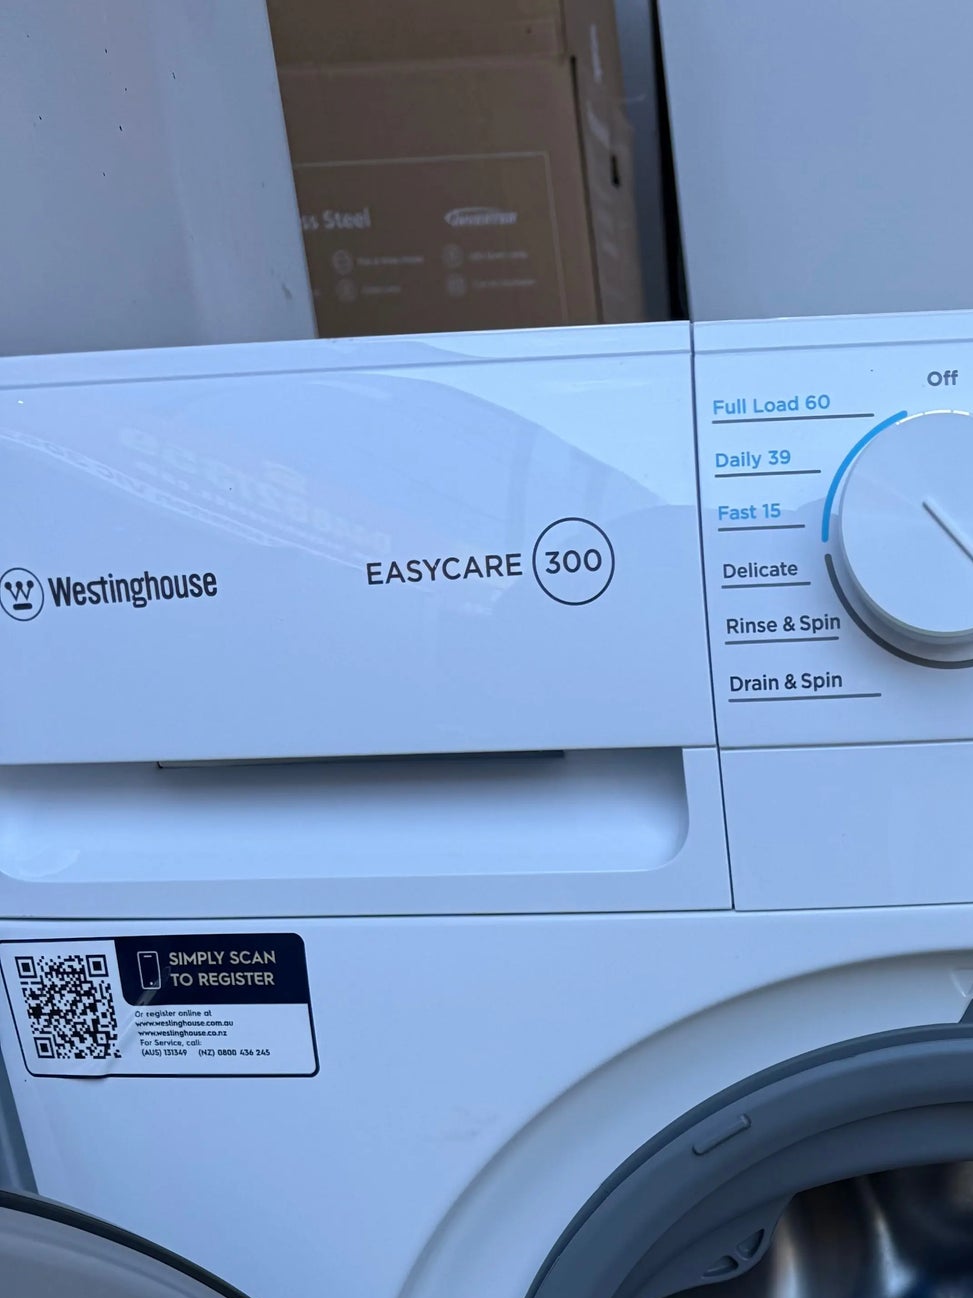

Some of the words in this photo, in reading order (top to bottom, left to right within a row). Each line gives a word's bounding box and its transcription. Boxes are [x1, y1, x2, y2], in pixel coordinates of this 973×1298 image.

[323, 207, 371, 230] Steel
[926, 370, 958, 387] Off
[713, 398, 747, 415] Full
[753, 396, 799, 413] Load
[805, 394, 831, 411] 60
[715, 450, 762, 469] Daily
[768, 450, 791, 465] 39
[718, 505, 757, 521] Fast
[762, 503, 782, 519] 15
[366, 553, 523, 586] EASYCARE
[545, 548, 603, 575] 300
[723, 562, 798, 579] Delicate
[48, 571, 218, 608] Westinghouse
[726, 617, 777, 634] Rinse
[783, 616, 796, 631] &
[799, 614, 841, 634] Spin
[729, 675, 779, 692] Drain
[784, 674, 797, 689] &
[801, 672, 843, 692] Spin
[169, 951, 225, 966] SIMPLY
[229, 950, 276, 965] SCAN
[171, 973, 194, 987] TO
[198, 972, 275, 986] REGISTER
[146, 1010, 176, 1018] register
[135, 1020, 234, 1029] www.westinghouse.com.au
[138, 1030, 228, 1038] www.westinghouse.co.nz
[141, 1049, 162, 1057] (AUS)
[198, 1049, 216, 1057] (NZ)
